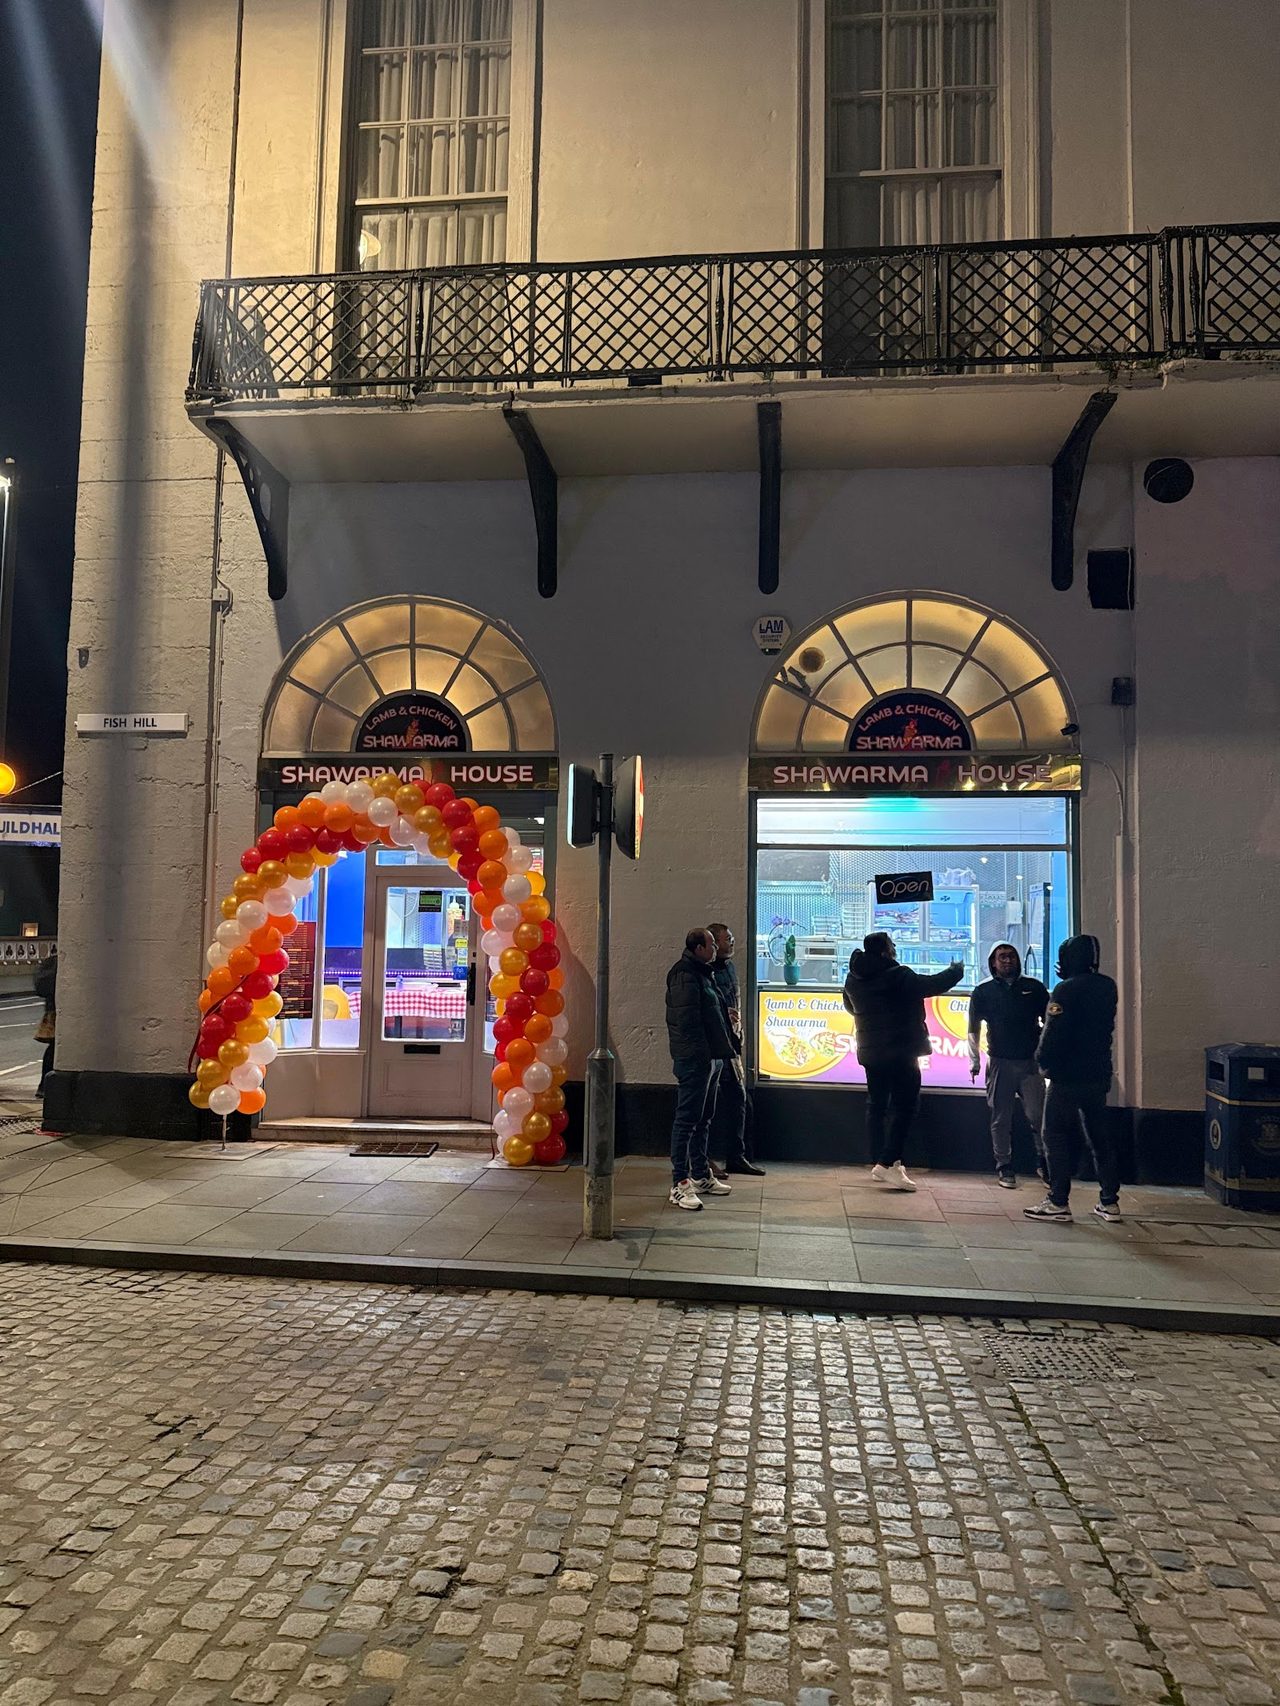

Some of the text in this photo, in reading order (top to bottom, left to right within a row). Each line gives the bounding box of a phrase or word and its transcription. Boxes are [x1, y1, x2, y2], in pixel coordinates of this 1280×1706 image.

[759, 620, 783, 633] LAM
[103, 717, 158, 728] FISH HILL
[365, 705, 457, 731] LAMB & CHICKEN
[858, 704, 961, 732] LAMB & CHICKEN
[363, 734, 459, 748] SHAWARMA
[856, 735, 962, 750] SHAWARMA
[450, 765, 534, 783] HOUSE
[773, 764, 1053, 784] SHAWARMA HOUSE
[880, 880, 930, 898] Open
[765, 998, 795, 1012] Lamb
[797, 998, 807, 1010] &
[765, 1016, 827, 1028] Shawarma
